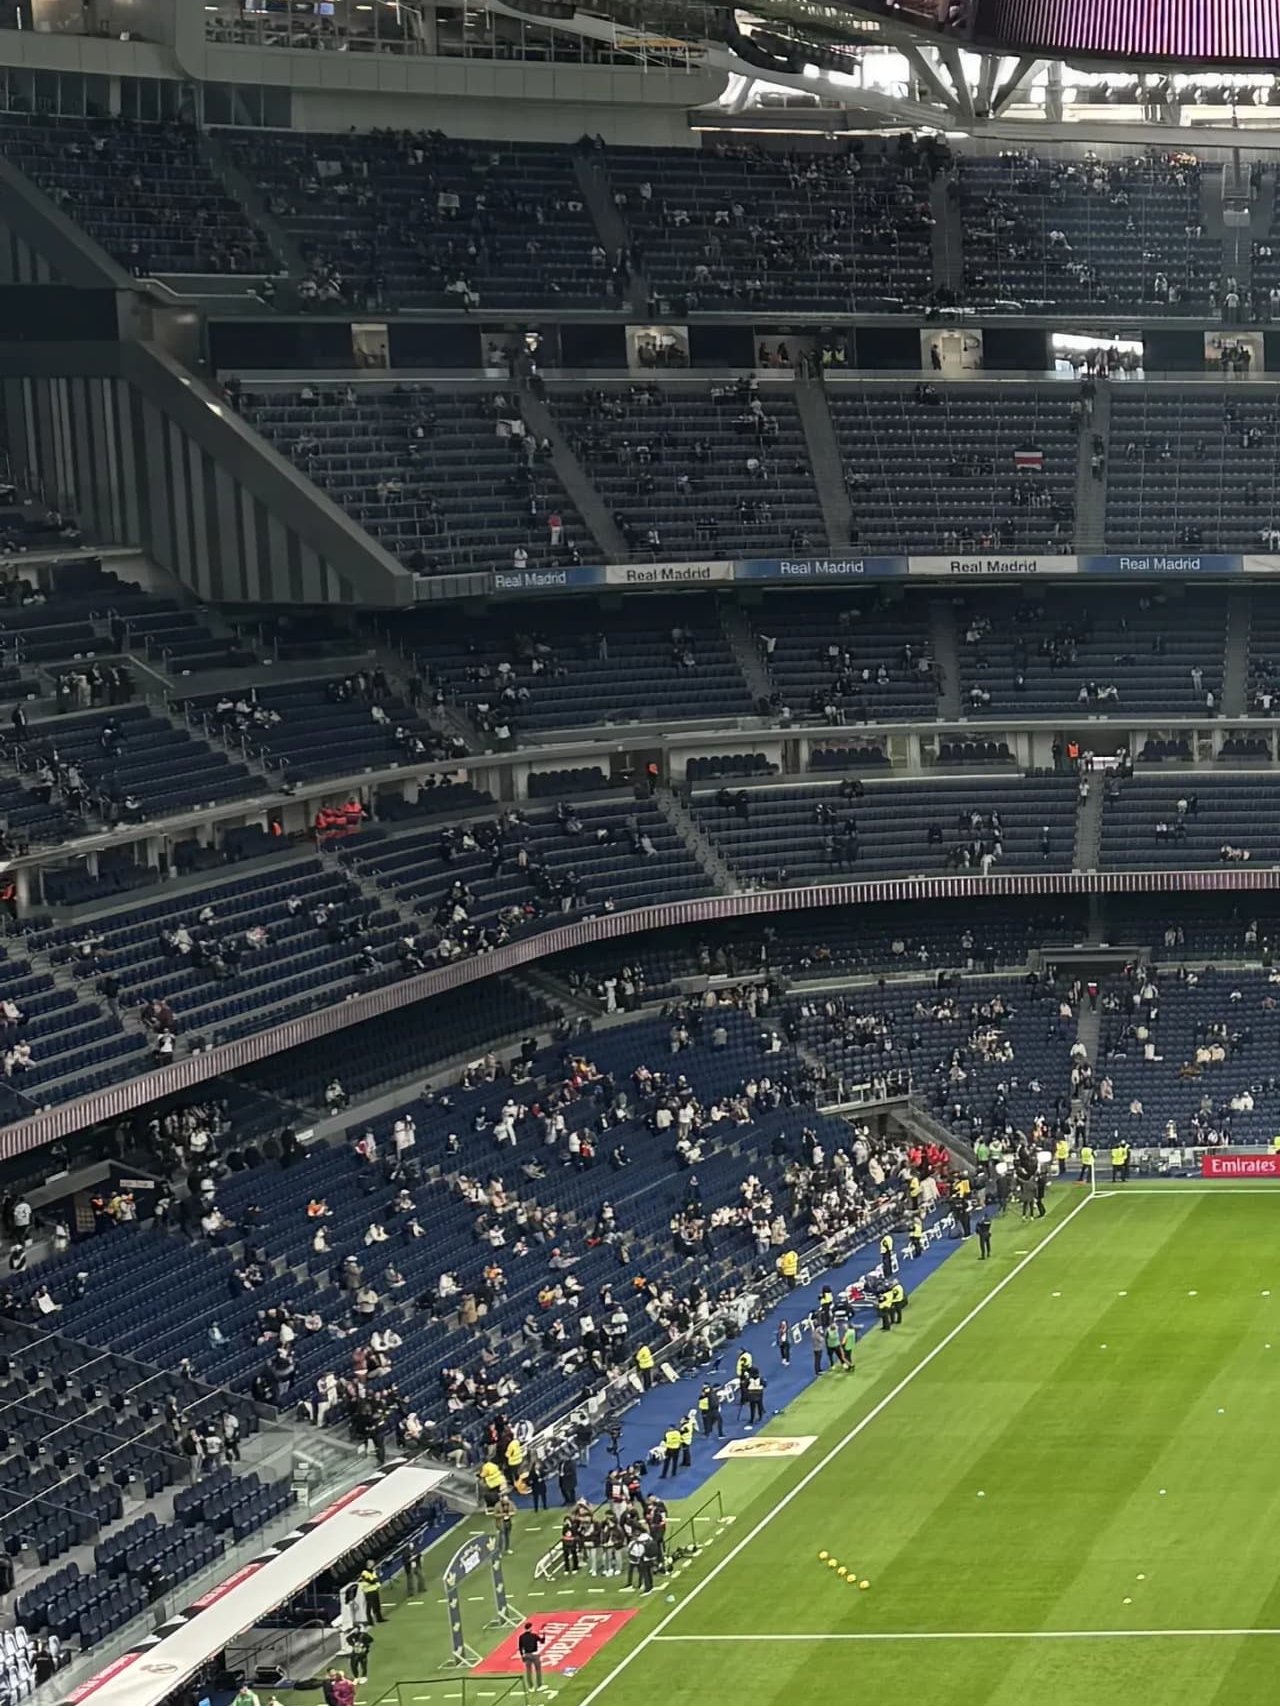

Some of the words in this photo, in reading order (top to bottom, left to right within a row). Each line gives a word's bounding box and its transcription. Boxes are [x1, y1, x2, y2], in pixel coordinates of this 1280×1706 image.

[781, 560, 810, 575] Real
[814, 559, 864, 574] Madrid
[950, 559, 980, 574] Real
[984, 558, 1037, 573] Madrid
[1120, 557, 1150, 570] Real
[1154, 556, 1200, 571] Madrid
[626, 567, 657, 582] Real
[661, 565, 711, 581] Madrid
[1211, 1158, 1277, 1173] Emirates
